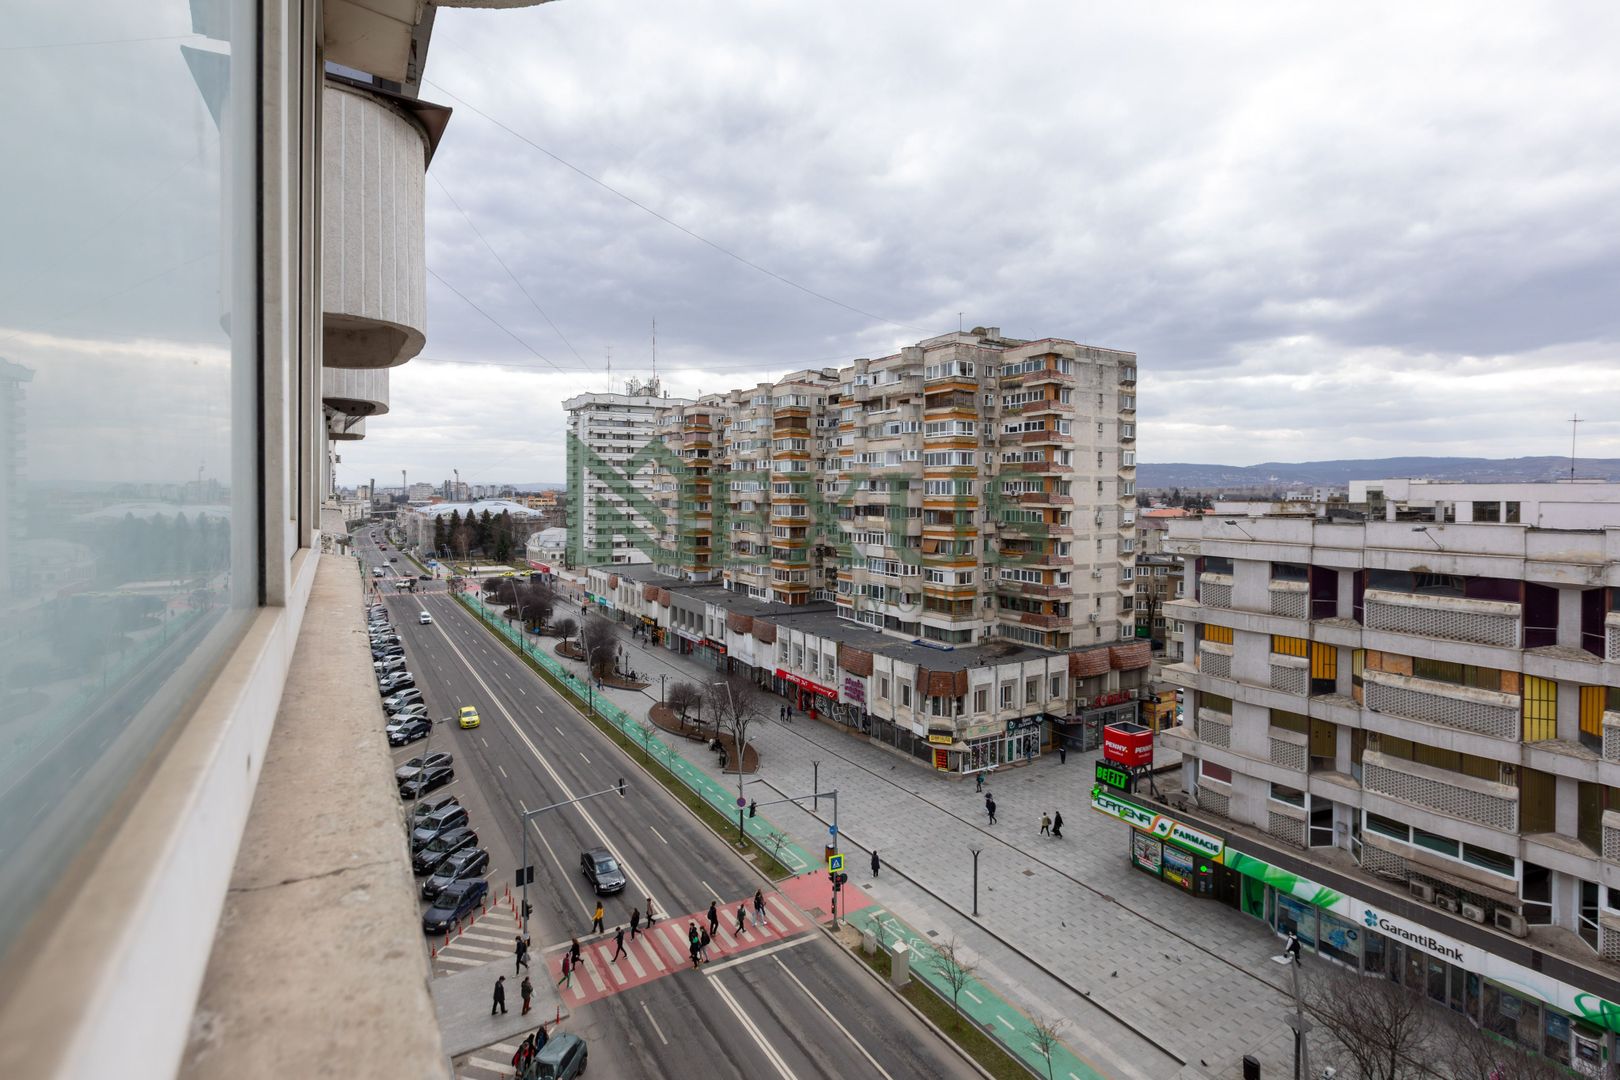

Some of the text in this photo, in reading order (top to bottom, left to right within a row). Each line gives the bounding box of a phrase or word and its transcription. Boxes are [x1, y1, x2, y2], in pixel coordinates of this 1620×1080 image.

[1097, 797, 1152, 826] CATENA
[1173, 828, 1220, 852] FARMACIE
[1379, 918, 1464, 963] GarantiBank
